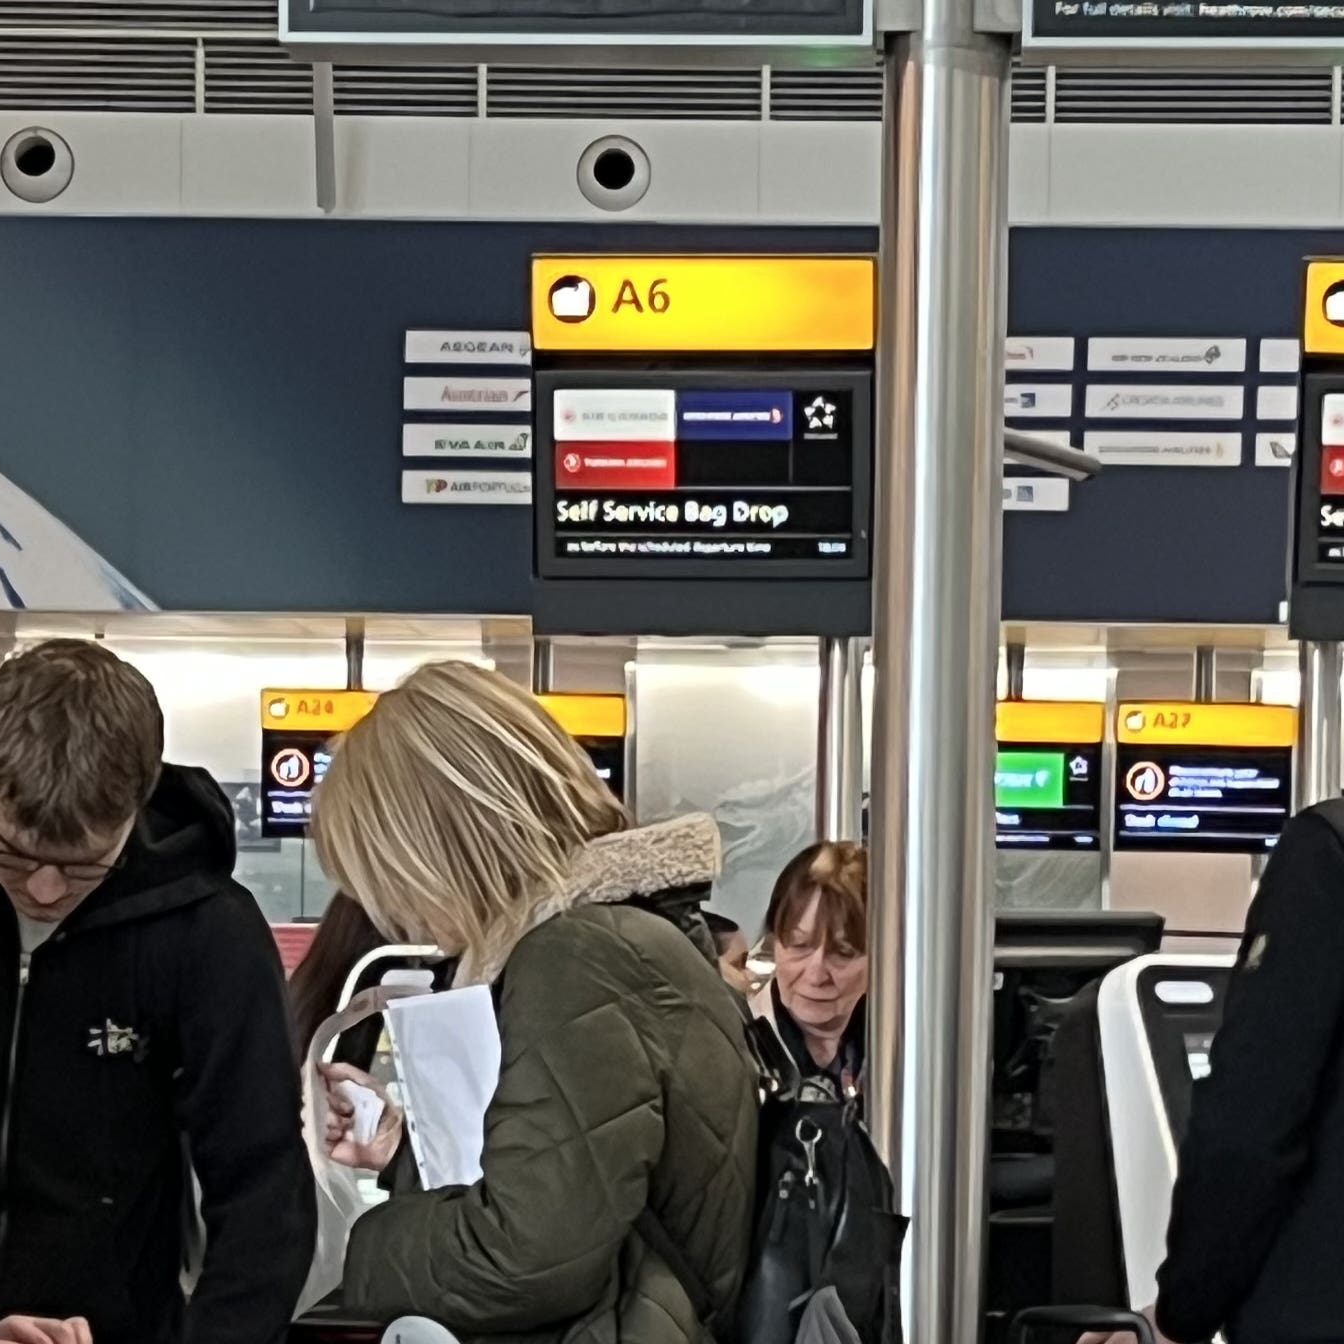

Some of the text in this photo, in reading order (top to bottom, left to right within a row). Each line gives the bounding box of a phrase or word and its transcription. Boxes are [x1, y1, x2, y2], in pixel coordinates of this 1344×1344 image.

[611, 278, 671, 314] A6
[439, 341, 514, 354] AEGEAN
[441, 385, 509, 403] Austrian
[556, 500, 789, 528] Self Service Bag Drop
[1152, 712, 1192, 729] A27
